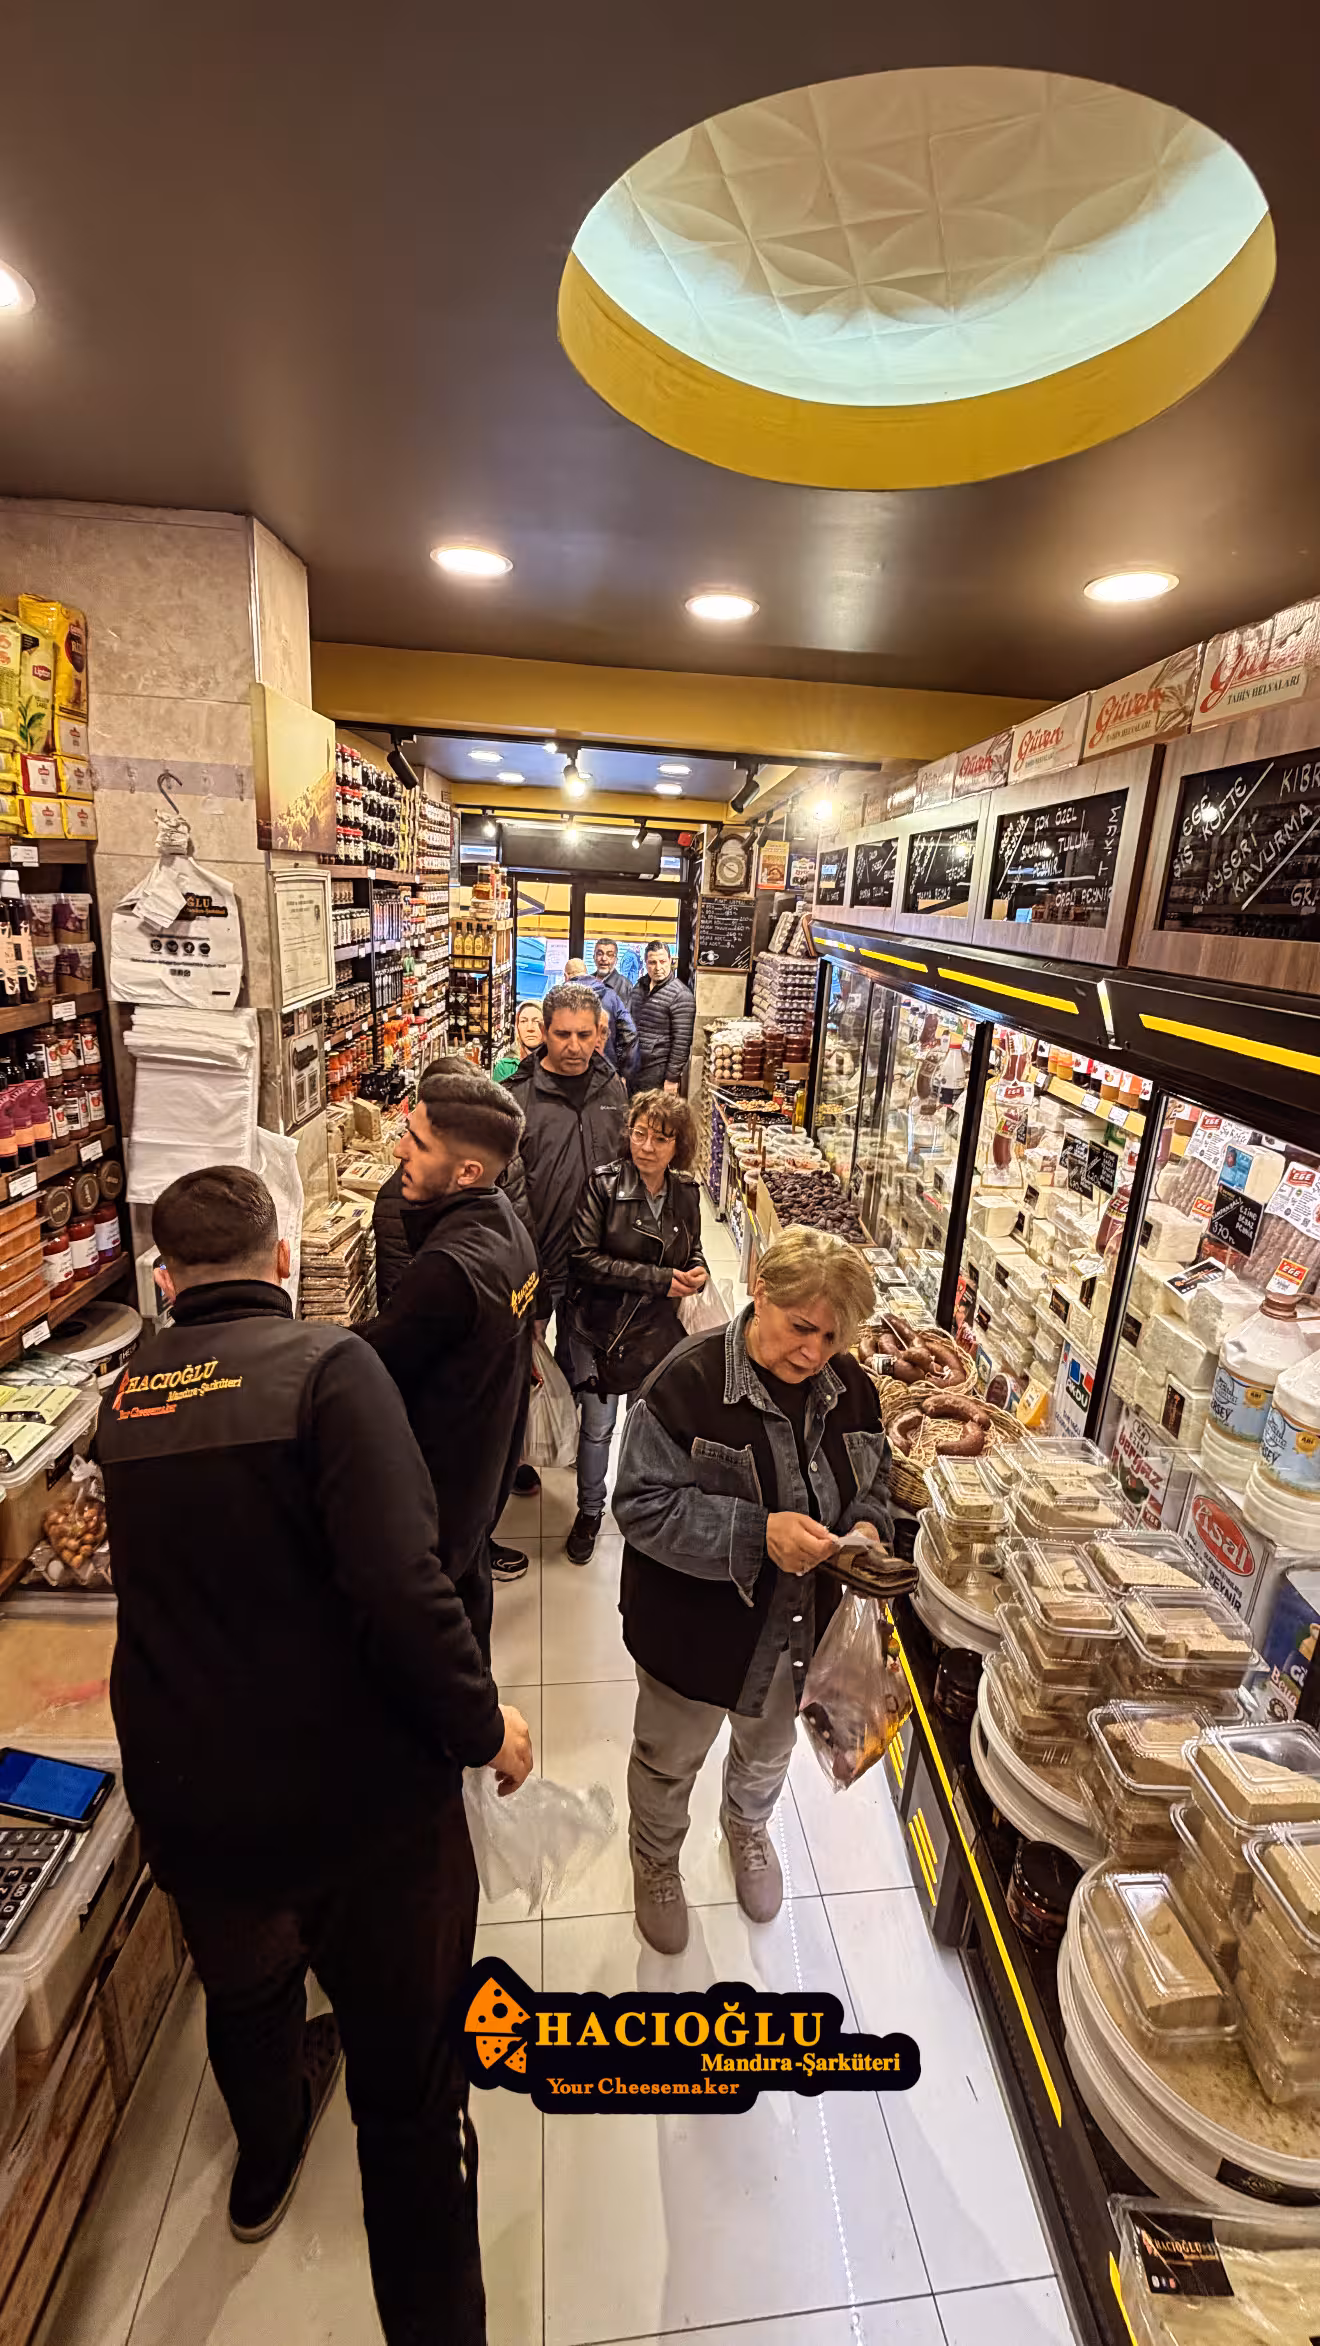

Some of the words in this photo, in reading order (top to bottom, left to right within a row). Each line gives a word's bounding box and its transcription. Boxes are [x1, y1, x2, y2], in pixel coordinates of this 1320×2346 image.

[1251, 674, 1300, 698] HELVALARI
[1089, 687, 1164, 749] Güven
[1013, 727, 1064, 773] Güven
[1231, 803, 1313, 898] KAVURMA
[1204, 1117, 1221, 1125] EGE
[1292, 1172, 1313, 1181] EGE
[1196, 1202, 1212, 1213] EGE
[1212, 1221, 1230, 1240] 370
[1283, 1264, 1302, 1277] EGE
[1208, 1570, 1243, 1613] PEYNİR
